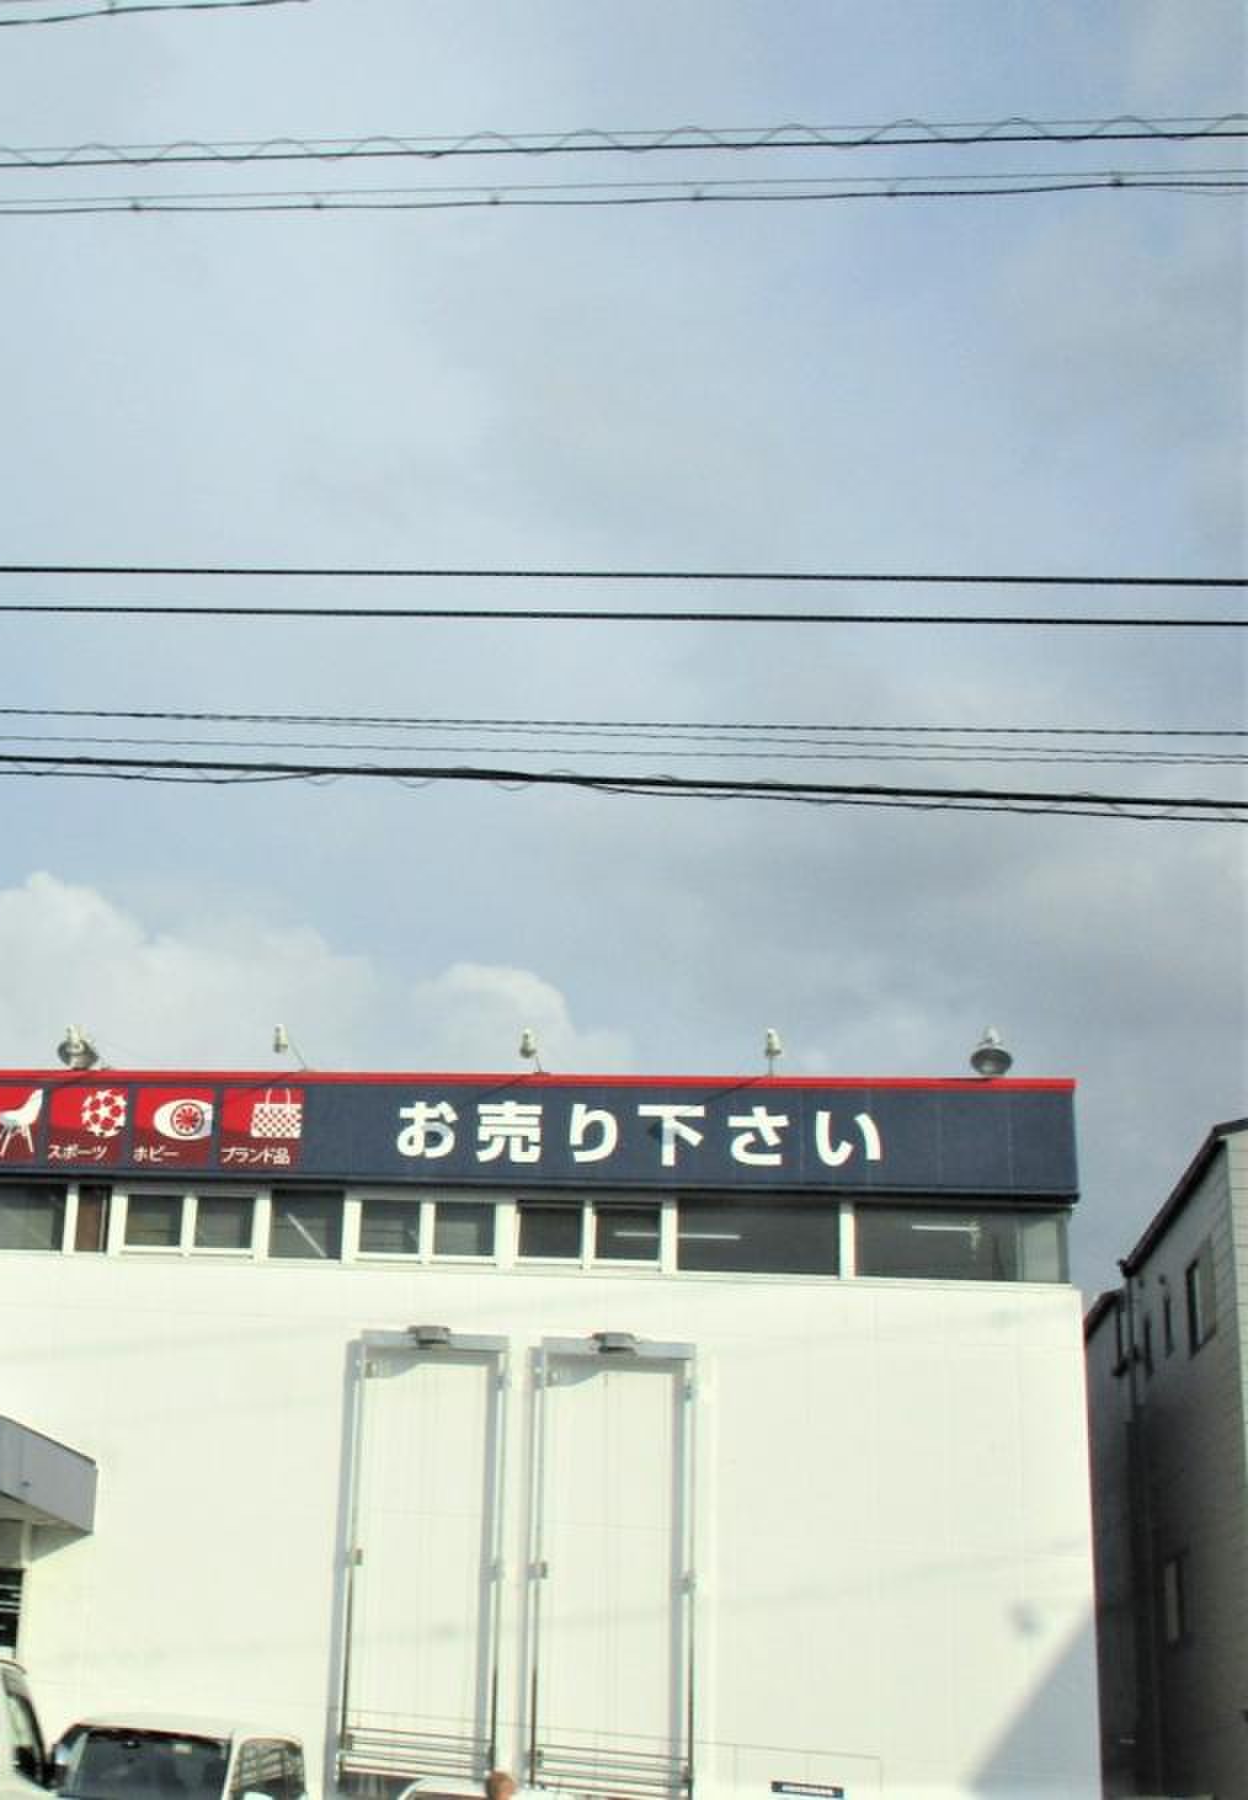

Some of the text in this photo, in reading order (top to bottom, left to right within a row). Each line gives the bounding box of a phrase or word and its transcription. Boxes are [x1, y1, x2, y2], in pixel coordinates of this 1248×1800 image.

[396, 1101, 882, 1168] お売り下さい
[47, 1143, 108, 1160] スポーツ
[132, 1145, 179, 1162] ホビー
[221, 1146, 291, 1165] ブランド品
